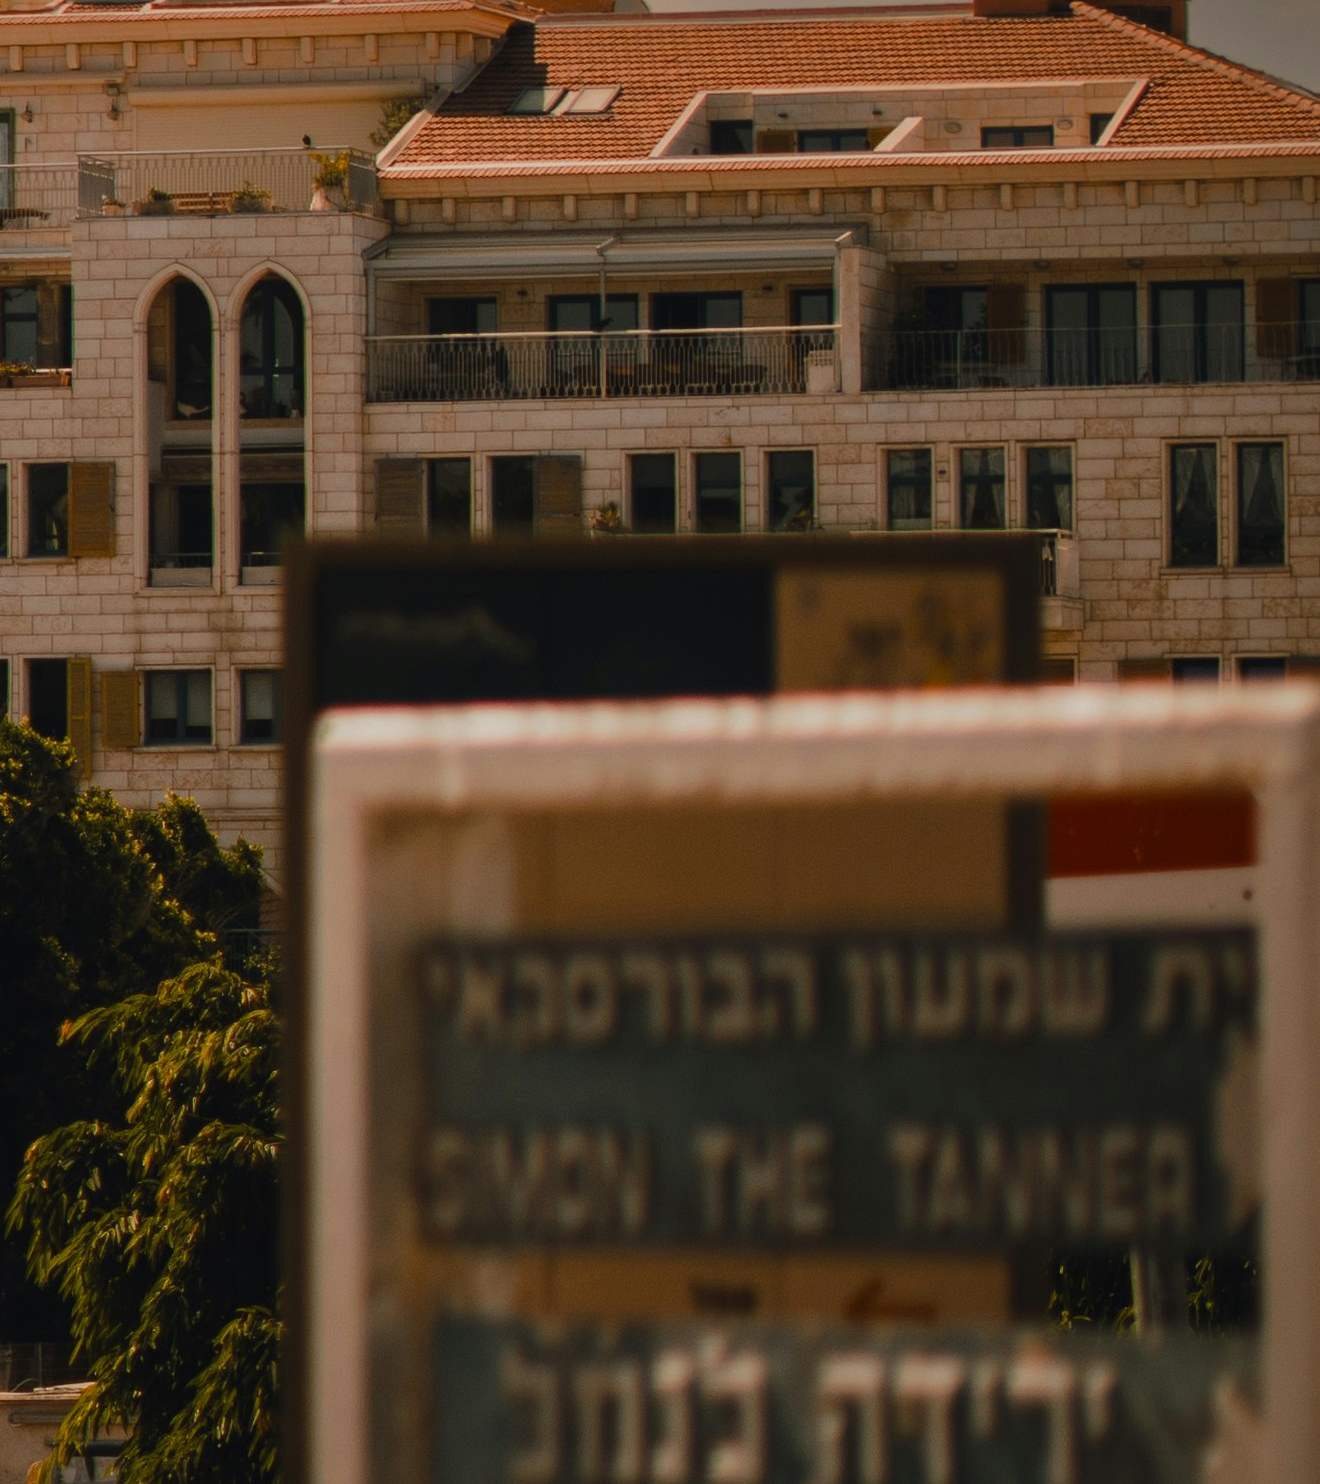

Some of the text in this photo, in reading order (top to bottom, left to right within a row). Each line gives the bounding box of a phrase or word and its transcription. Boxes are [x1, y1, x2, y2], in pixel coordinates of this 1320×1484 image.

[839, 946, 1116, 1056] שמעון
[691, 1120, 839, 1234] THE
[887, 1120, 1201, 1236] TANNER
